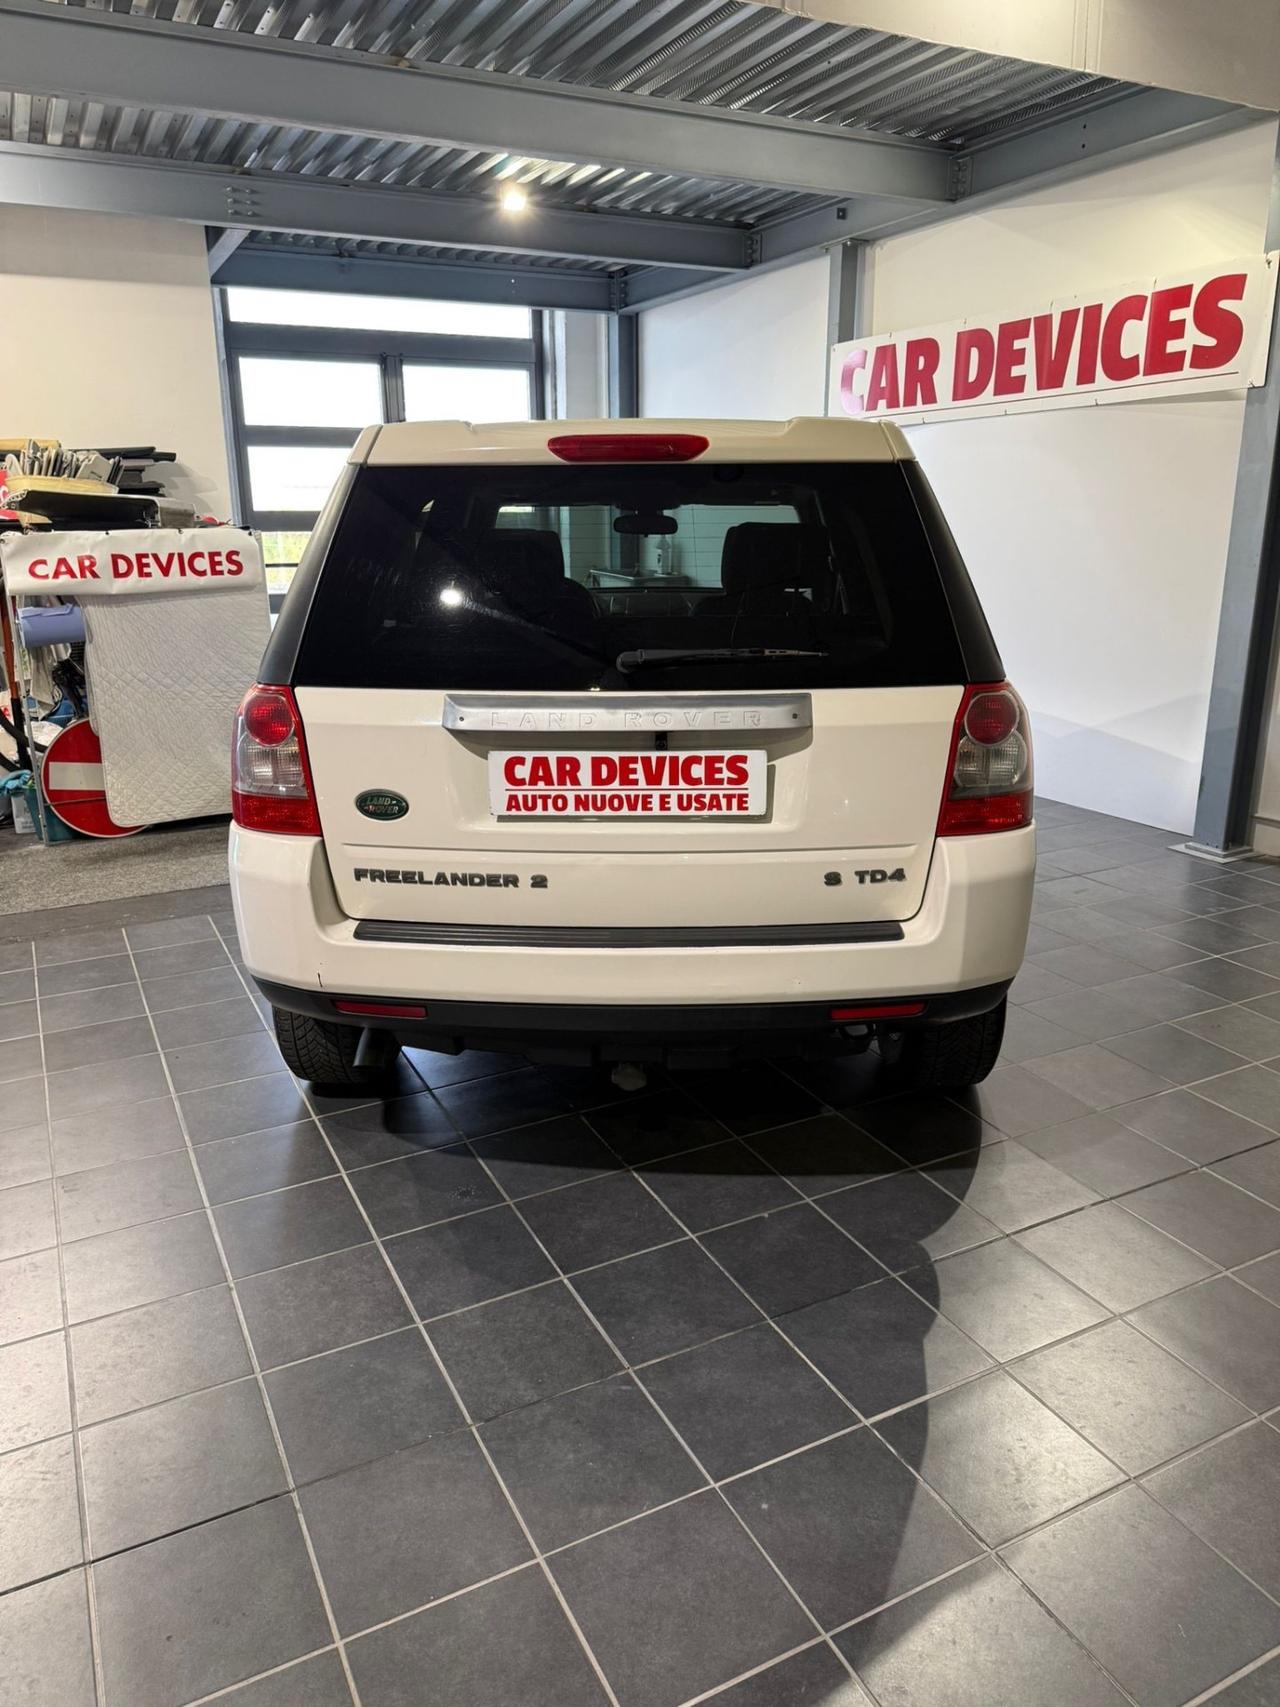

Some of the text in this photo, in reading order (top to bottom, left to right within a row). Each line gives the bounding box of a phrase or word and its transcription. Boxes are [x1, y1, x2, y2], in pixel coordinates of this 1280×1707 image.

[840, 273, 1248, 416] CAR DEVICES
[28, 550, 245, 581] CAR DEVICES
[489, 709, 763, 730] LAND ROVER
[503, 755, 750, 787] CAR DEVICES
[505, 792, 750, 812] AUTO NUOVE E USATE
[353, 867, 549, 889] FREELANDER 2
[823, 867, 907, 887] S TD4
